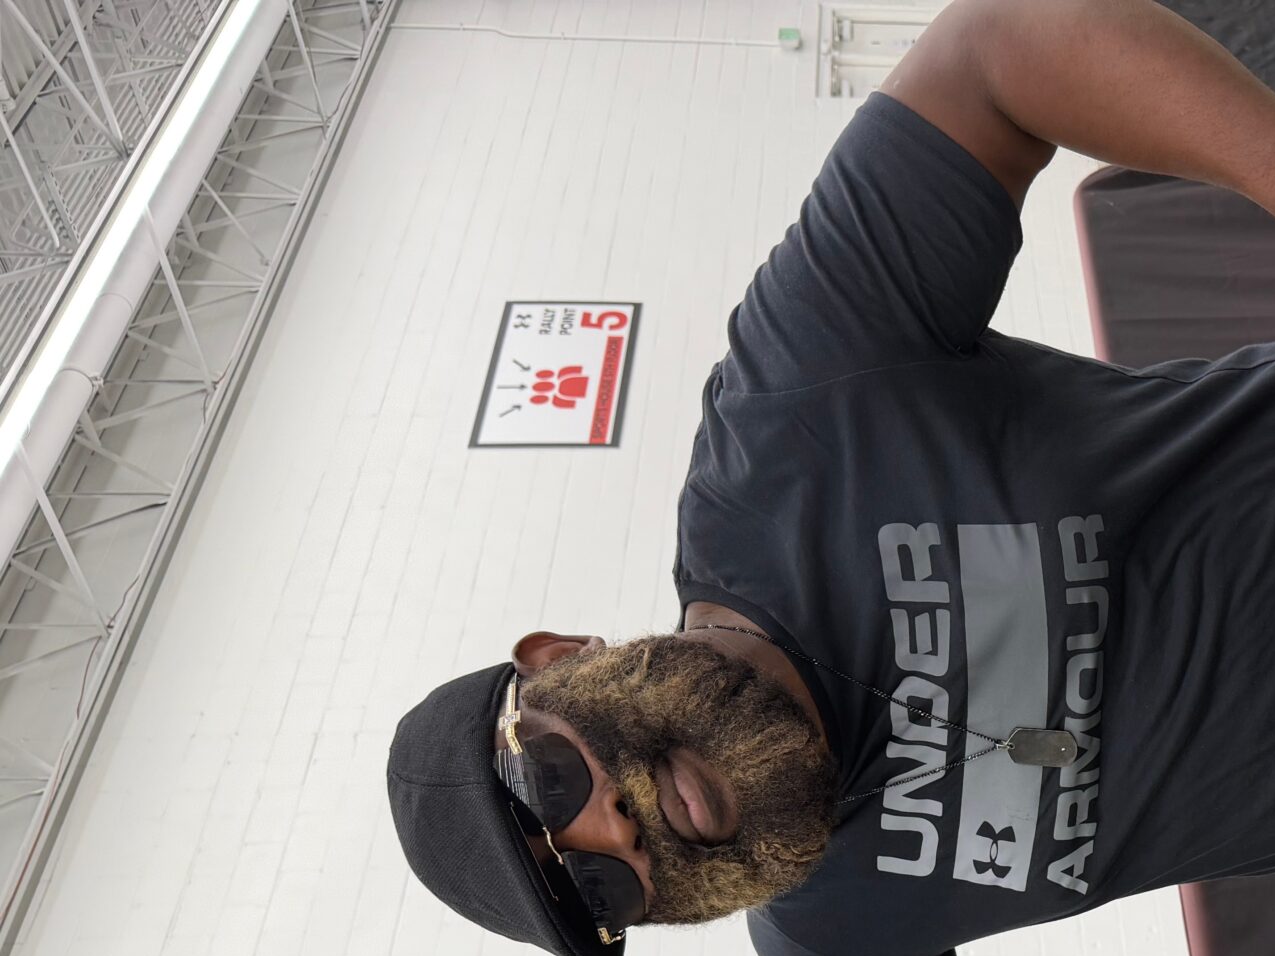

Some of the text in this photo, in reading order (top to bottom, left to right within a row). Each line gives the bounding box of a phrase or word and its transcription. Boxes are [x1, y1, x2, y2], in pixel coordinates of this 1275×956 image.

[539, 308, 556, 335] RALLY
[560, 308, 576, 335] POINT
[580, 311, 628, 330] 5
[877, 522, 950, 877] UNDER
[1047, 514, 1110, 895] ARMOUR
